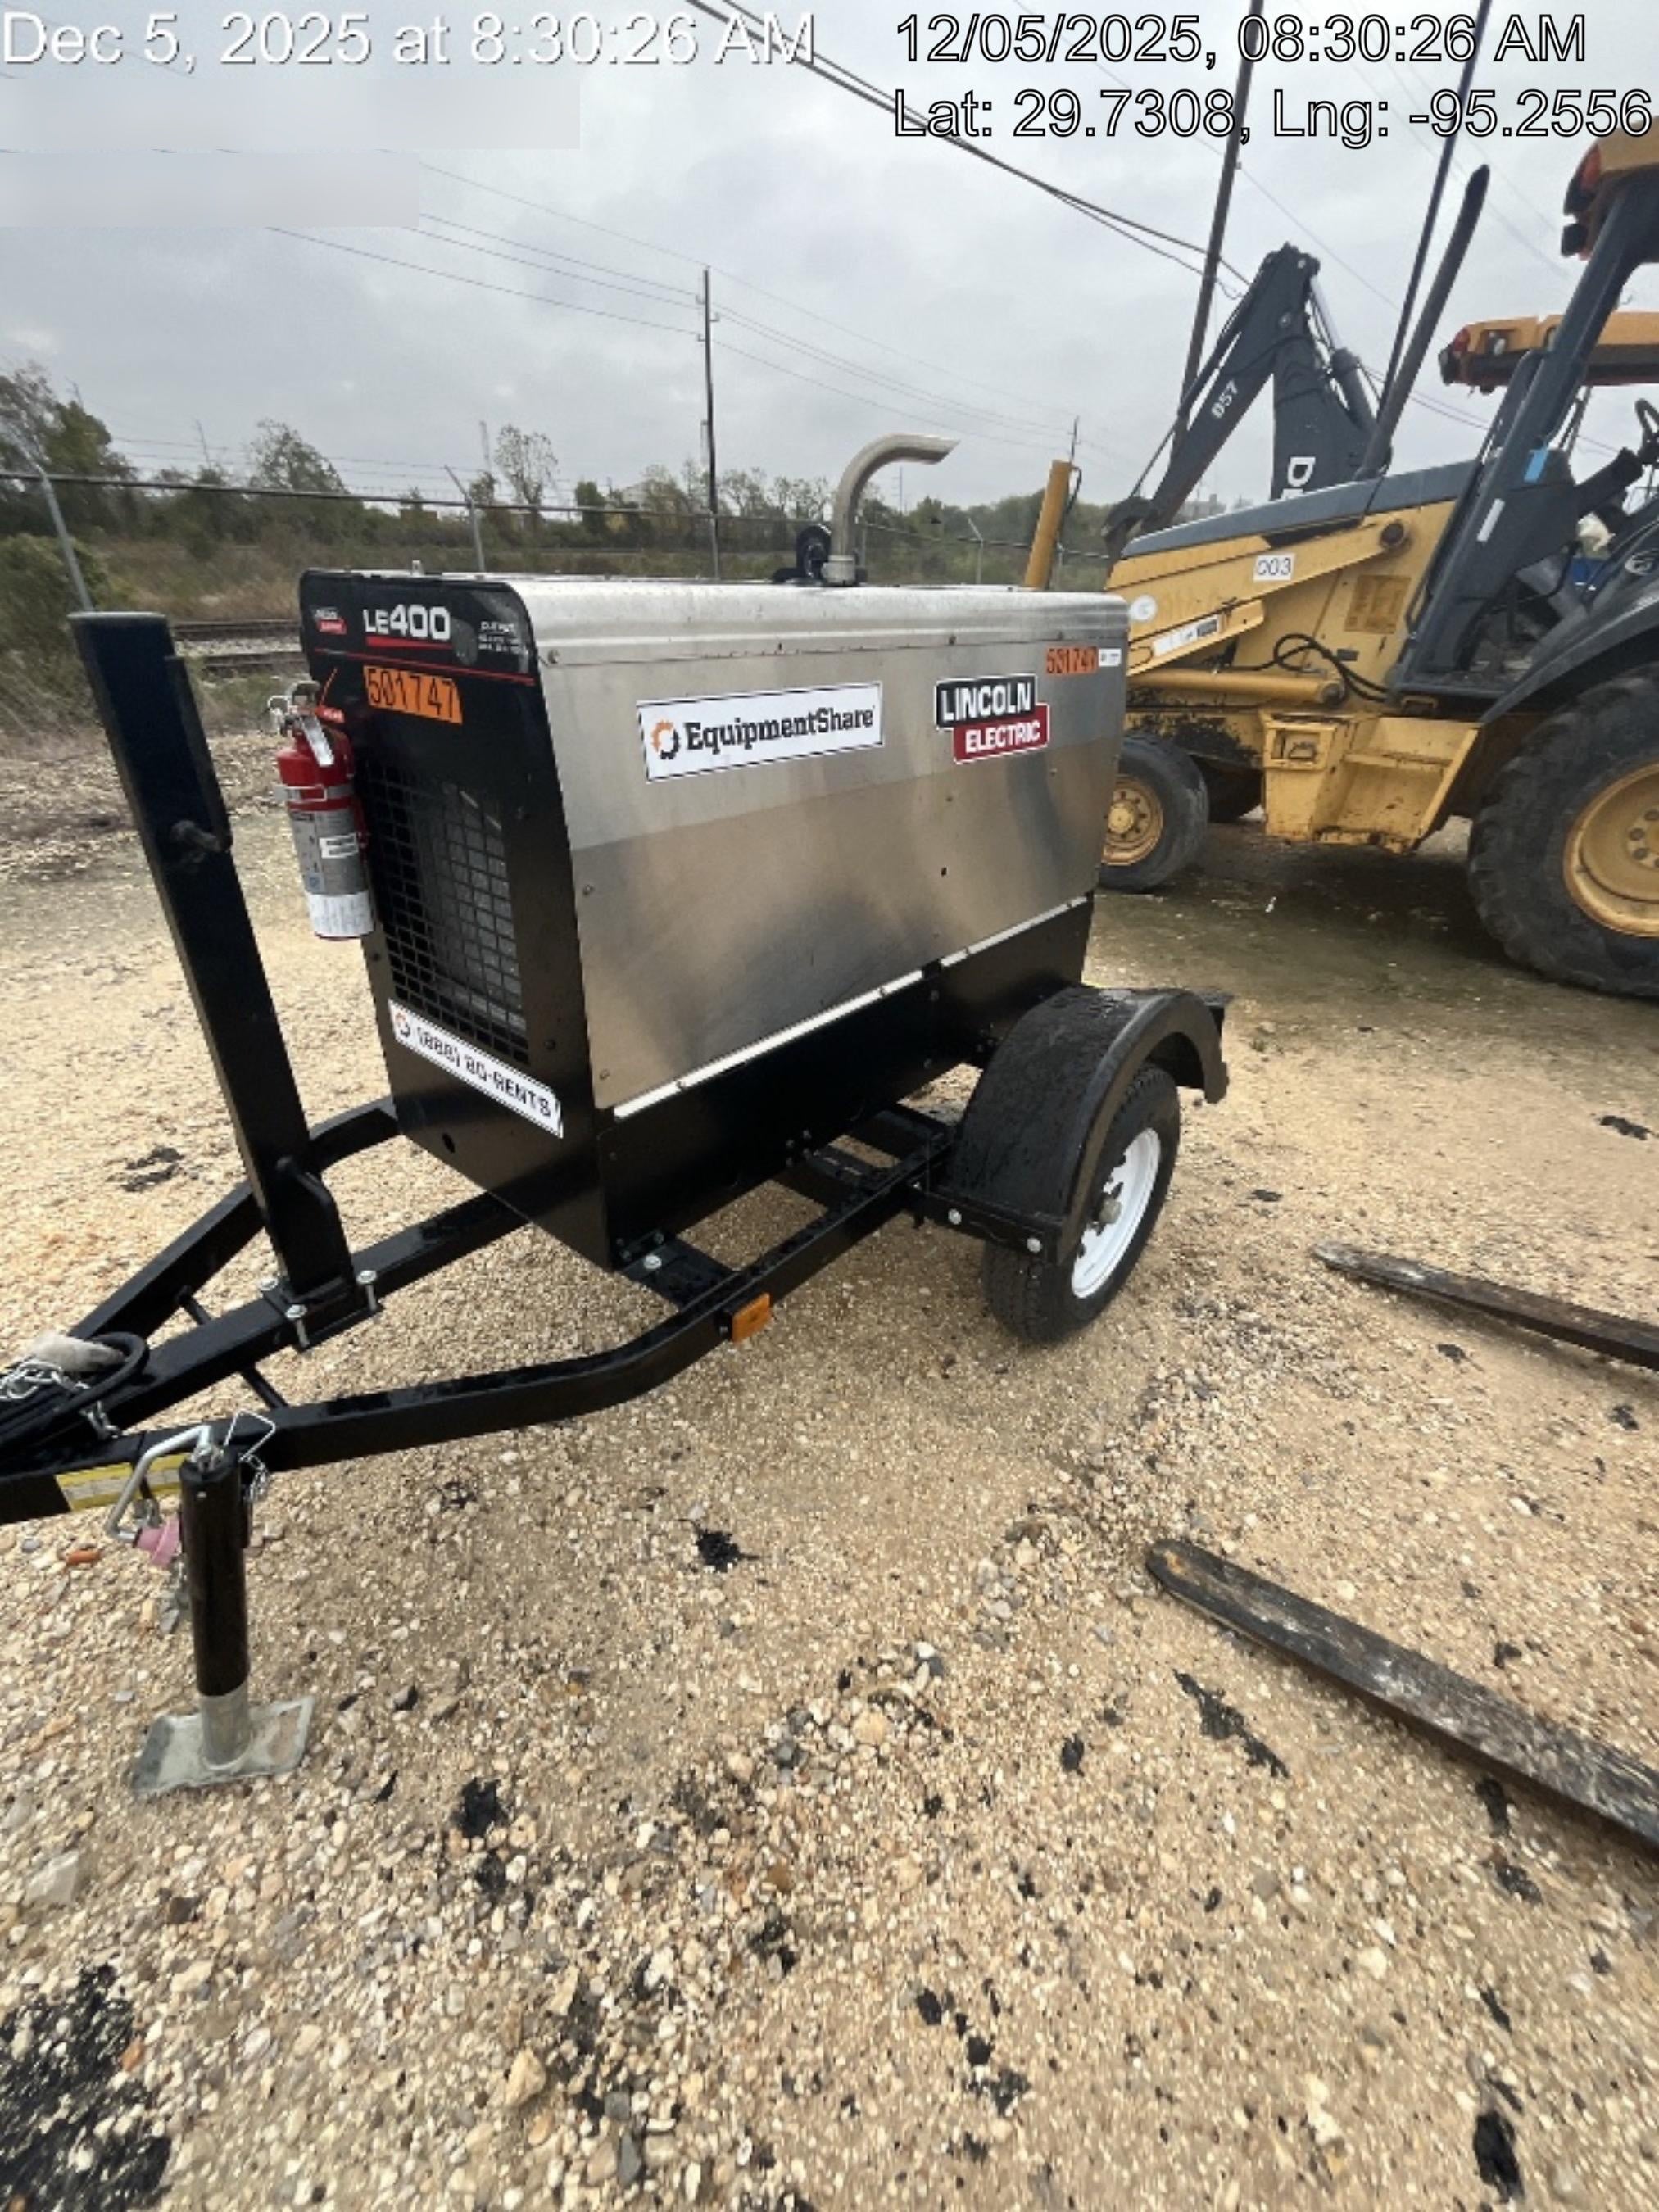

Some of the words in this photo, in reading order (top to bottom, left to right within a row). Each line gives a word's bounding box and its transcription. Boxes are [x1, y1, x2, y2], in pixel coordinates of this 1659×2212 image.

[362, 604, 451, 640] LE400
[367, 668, 456, 719] 501747
[940, 681, 1032, 721] LINCOLN
[684, 704, 875, 755] EquipmentShare
[964, 719, 1042, 754] ELECTRIC
